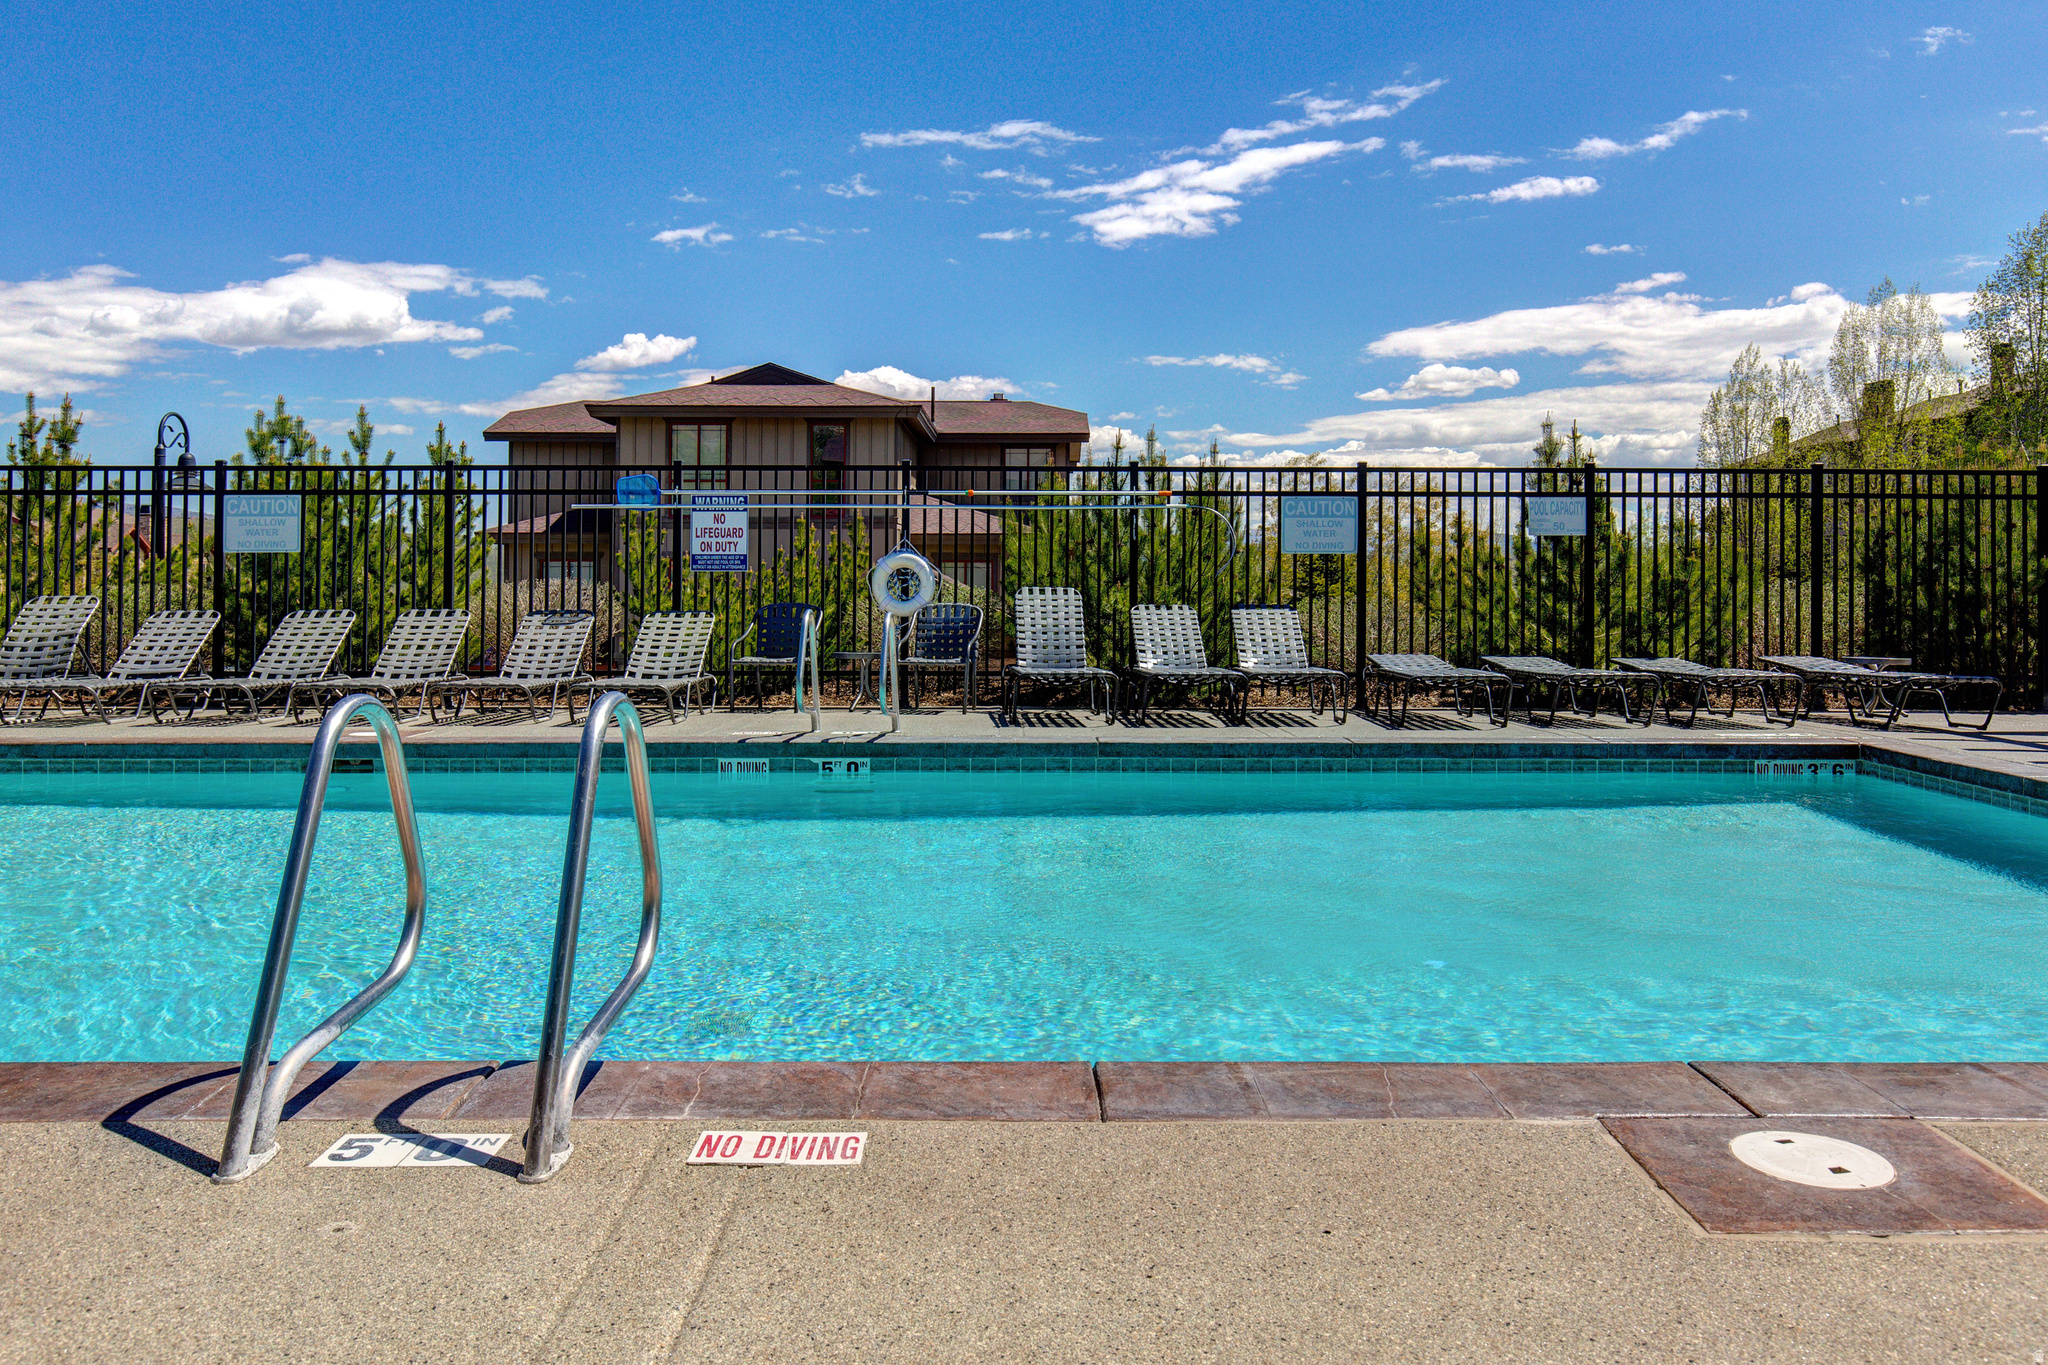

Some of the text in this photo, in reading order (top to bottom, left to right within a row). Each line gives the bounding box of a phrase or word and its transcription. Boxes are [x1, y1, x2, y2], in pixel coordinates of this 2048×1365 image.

[227, 499, 298, 514] CAUTION
[695, 497, 745, 510] WARNING
[1285, 501, 1355, 515] CAUTION
[1529, 501, 1585, 516] POOL CAPACITY
[239, 518, 286, 526] SHALLOW
[713, 513, 726, 524] NO
[245, 528, 279, 536] WATER
[1553, 522, 1565, 531] 50
[695, 527, 744, 538] LIFEGUARD
[237, 540, 287, 548] NO DIVING
[700, 541, 739, 552] ON DUTY
[720, 761, 767, 772] NO DIVING
[822, 761, 834, 772] 5
[1757, 763, 1804, 774] NO DIVING
[1808, 763, 1818, 774] 3
[1832, 763, 1844, 774] 6
[327, 1137, 501, 1162] 5 FT 0 IN
[695, 1134, 860, 1160] NO DIVING
